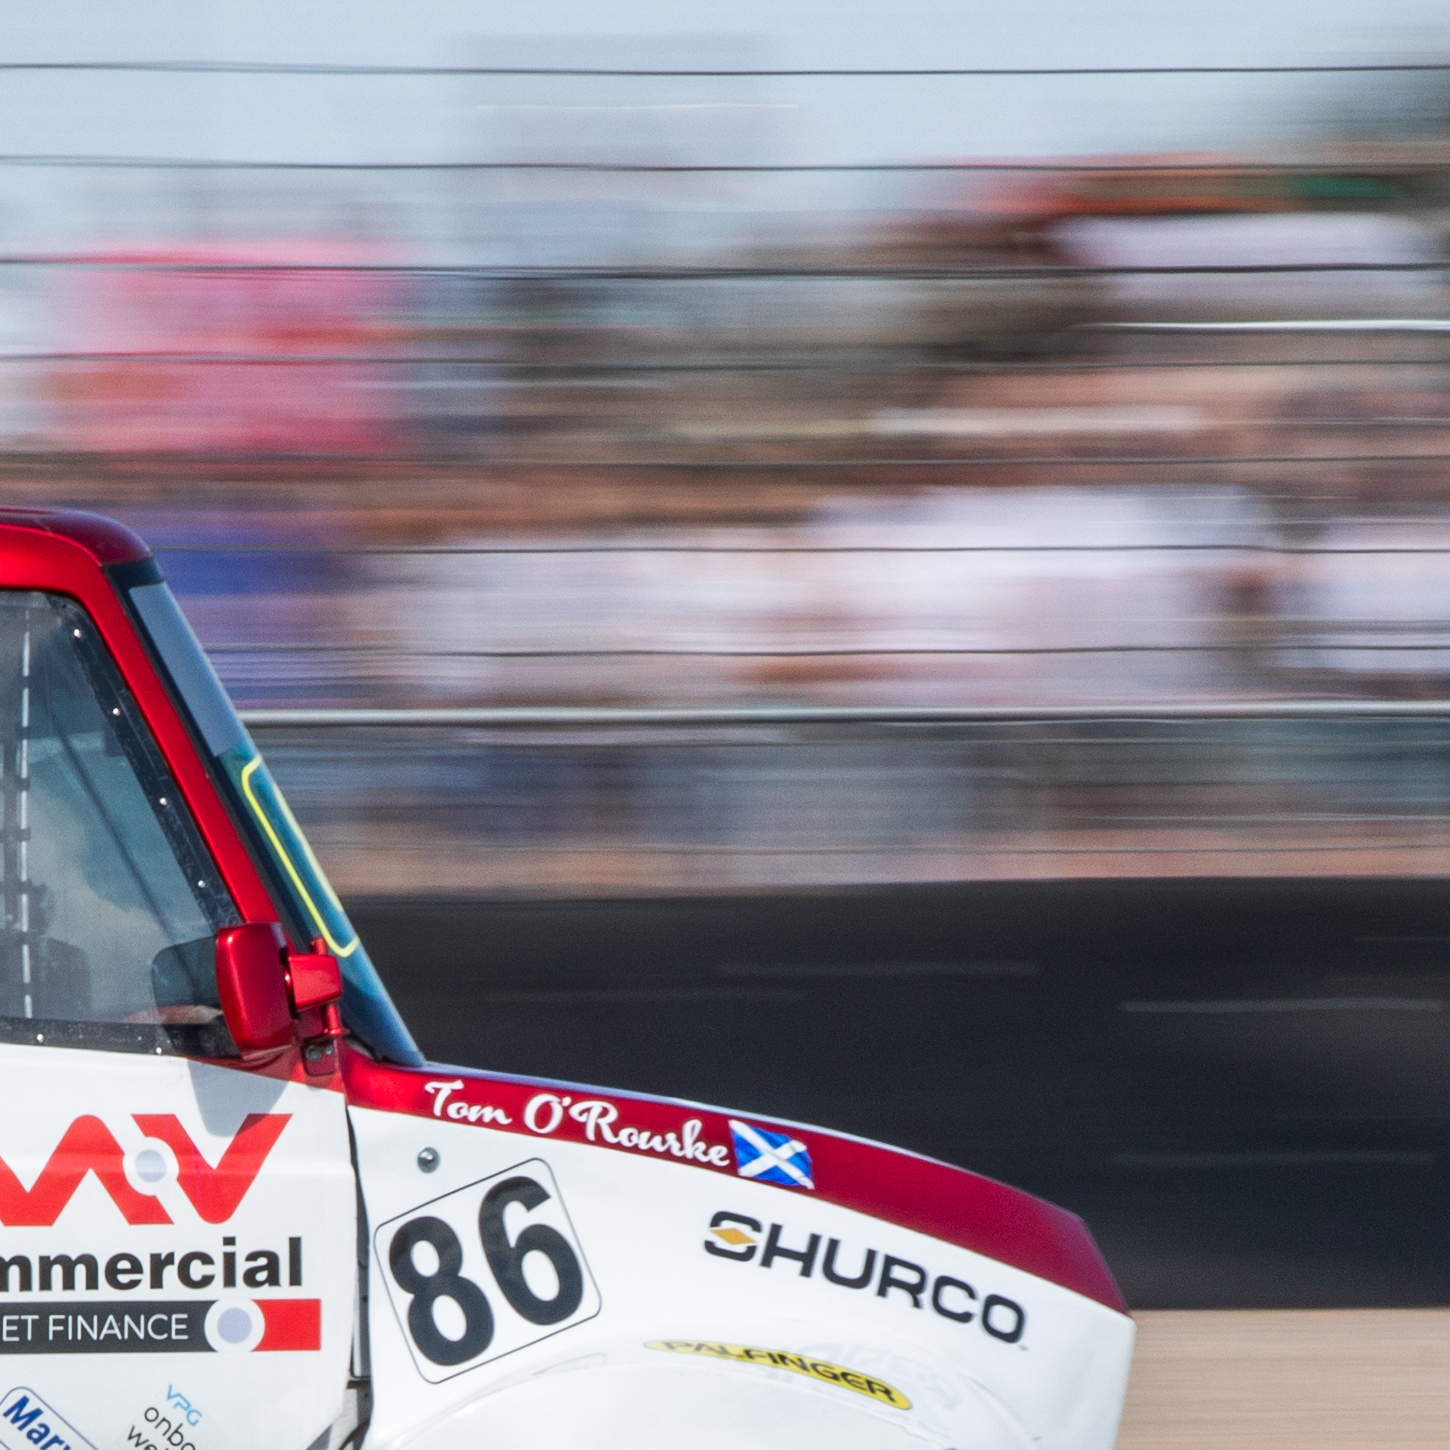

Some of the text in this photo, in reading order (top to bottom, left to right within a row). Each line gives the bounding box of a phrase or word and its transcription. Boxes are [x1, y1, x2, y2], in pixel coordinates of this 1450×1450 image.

[424, 1079, 730, 1168] Tom O'Rourke
[388, 1175, 584, 1366] 86
[704, 1211, 1026, 1344] SHURCO
[48, 1313, 188, 1341] FINANCE
[167, 1385, 202, 1427] VPG
[662, 1340, 896, 1402] PALFINGER
